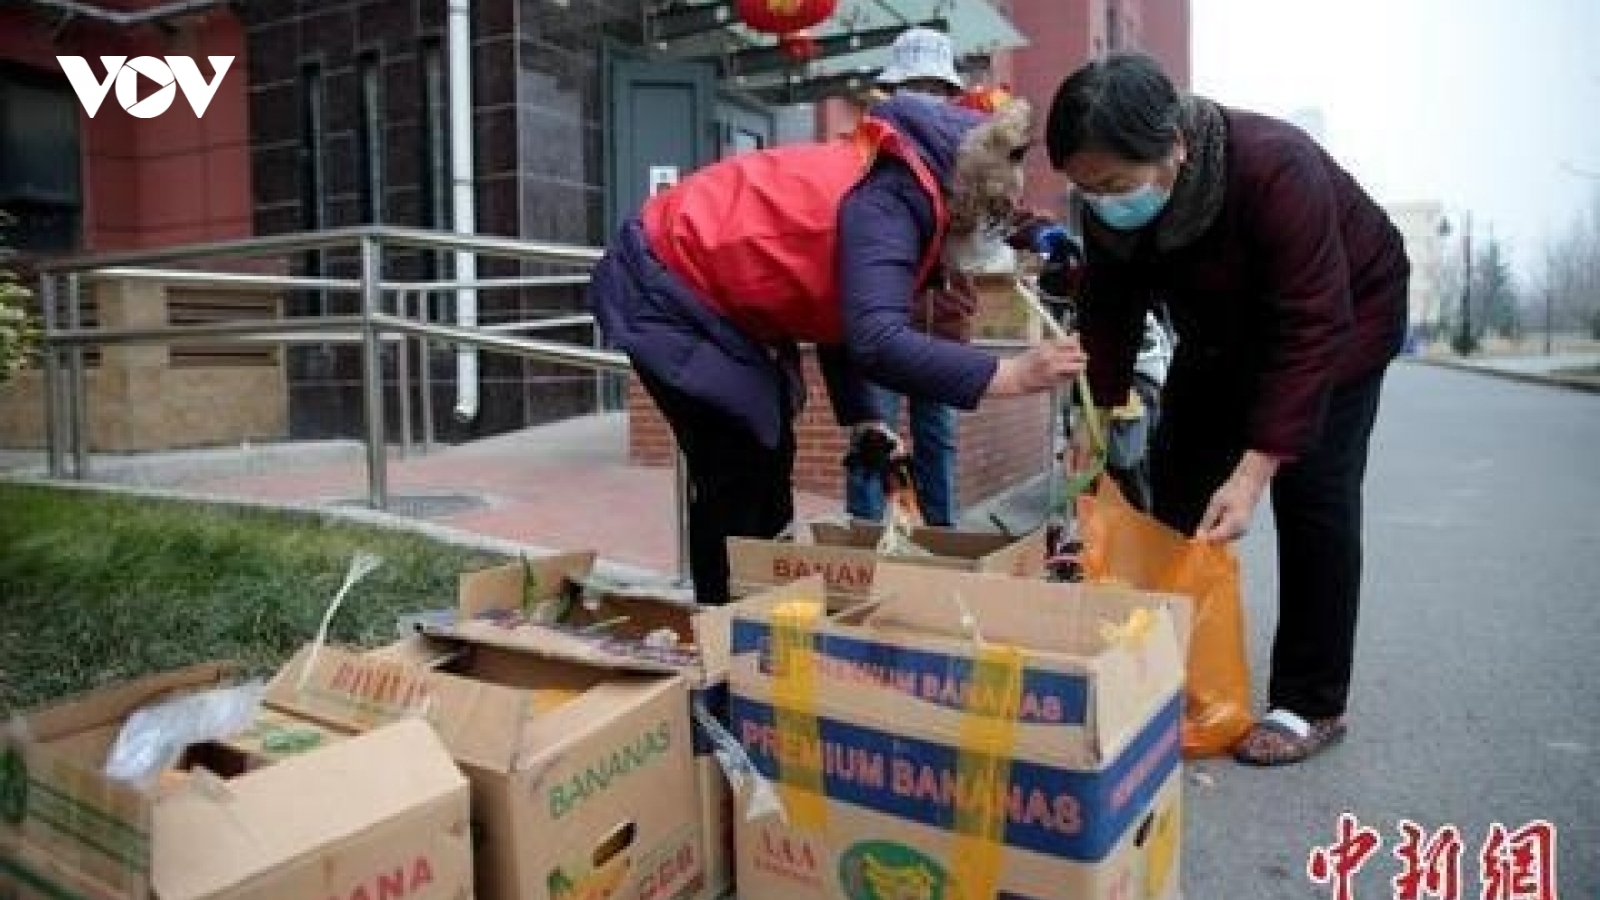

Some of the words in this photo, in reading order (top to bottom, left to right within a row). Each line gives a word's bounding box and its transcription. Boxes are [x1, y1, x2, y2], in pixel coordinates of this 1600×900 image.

[548, 720, 671, 820] BANANAS
[741, 718, 885, 791] PREMIUM
[892, 758, 1082, 834] BANANAS
